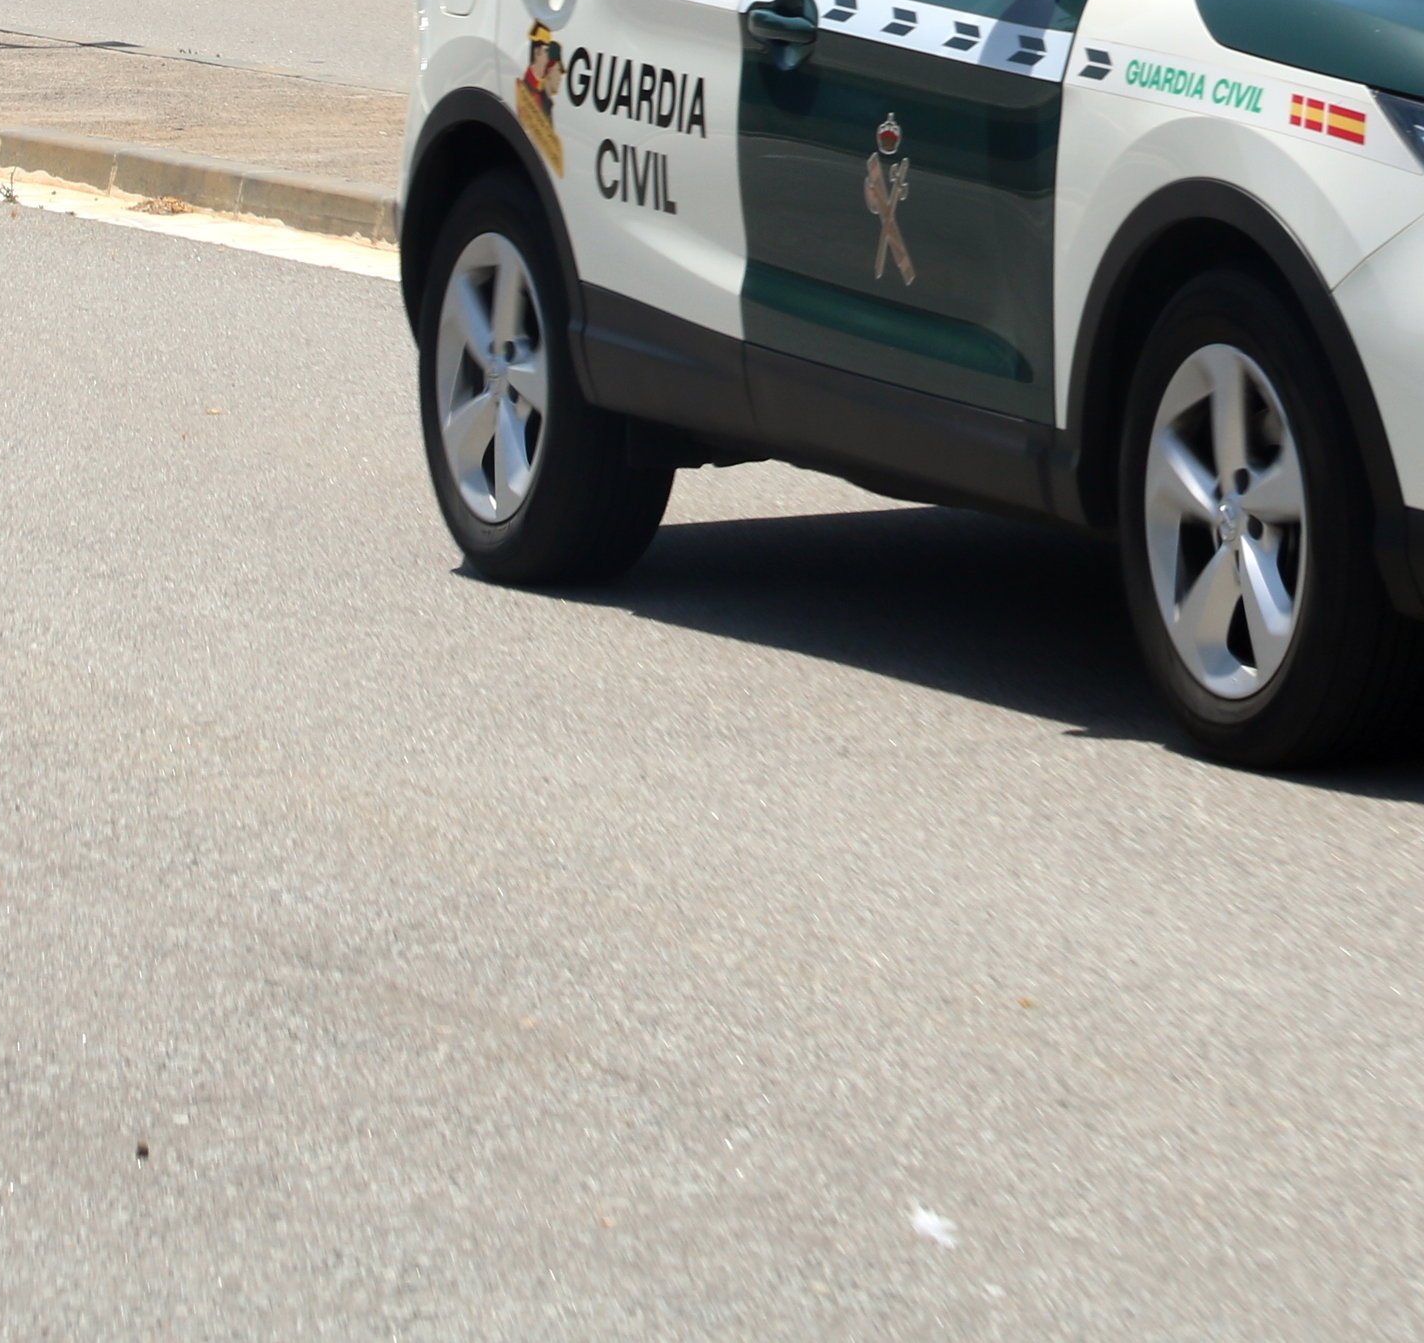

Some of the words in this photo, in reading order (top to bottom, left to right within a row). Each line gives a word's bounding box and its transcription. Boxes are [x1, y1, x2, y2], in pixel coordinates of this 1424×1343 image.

[566, 46, 707, 139] GUARDIA
[1126, 59, 1206, 100] GUARDIA
[1212, 78, 1264, 113] CIVIL
[596, 138, 678, 215] CIVIL
